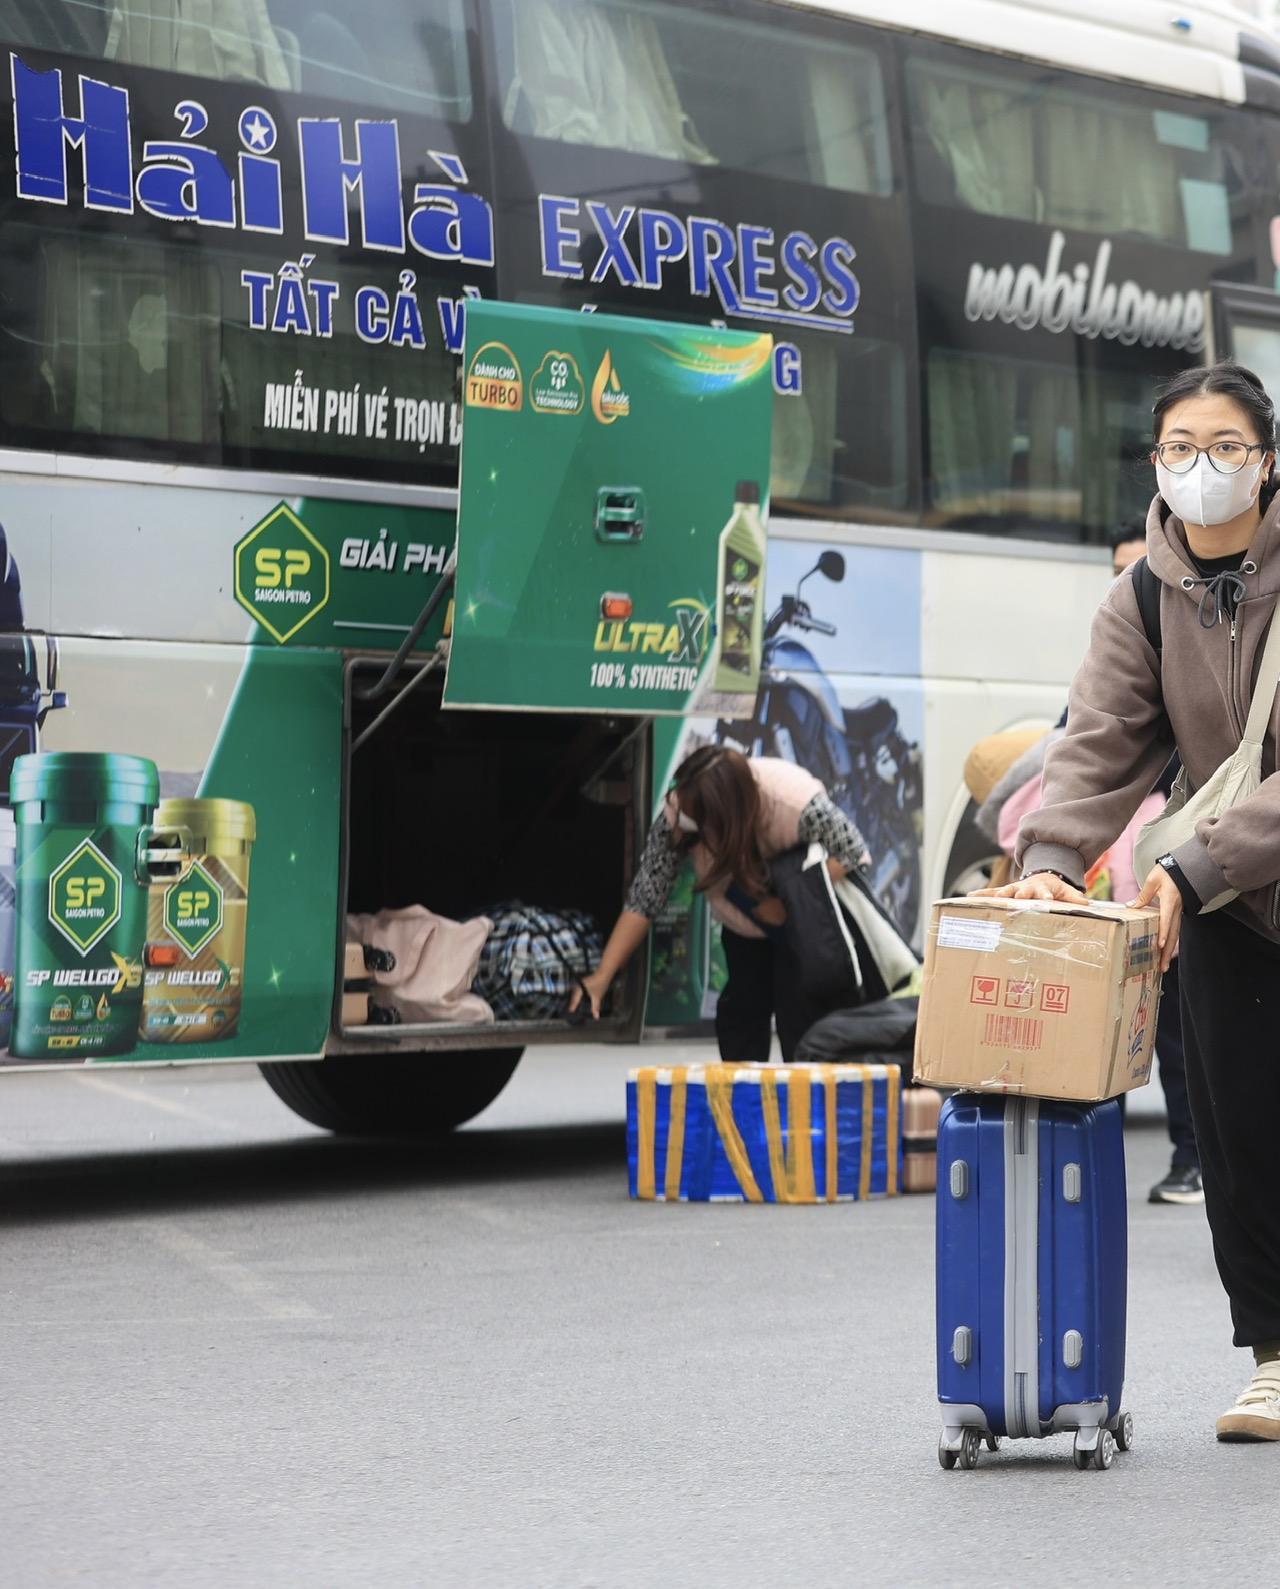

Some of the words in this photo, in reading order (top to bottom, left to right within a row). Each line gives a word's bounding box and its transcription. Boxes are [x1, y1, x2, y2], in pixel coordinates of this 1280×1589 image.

[10, 52, 284, 235] Hải
[298, 117, 496, 267] Hà
[538, 194, 861, 334] EXPRESS
[241, 254, 340, 338] TẤT
[355, 269, 427, 349] CẢ
[471, 381, 518, 406] TURBO
[264, 369, 319, 432] MIỄN
[324, 383, 360, 436] PHÍ
[364, 386, 389, 439] VÉ
[394, 397, 445, 453] TRỌN
[339, 529, 397, 570] GIẢI
[255, 547, 311, 588] SP
[255, 588, 284, 603] SAIGON
[285, 590, 311, 605] PETRO
[591, 663, 626, 689] 100%
[629, 665, 698, 691] SYNTHETIC
[66, 877, 105, 907] SP
[177, 891, 210, 918] SP
[65, 907, 86, 918] SAIGON
[87, 907, 105, 918] PETRO
[177, 918, 194, 928] SAIGON
[25, 969, 51, 987] SP
[53, 968, 119, 987] WELLGO
[144, 972, 165, 987] SP
[167, 970, 222, 987] WELLGO
[1046, 987, 1066, 1002] 07
